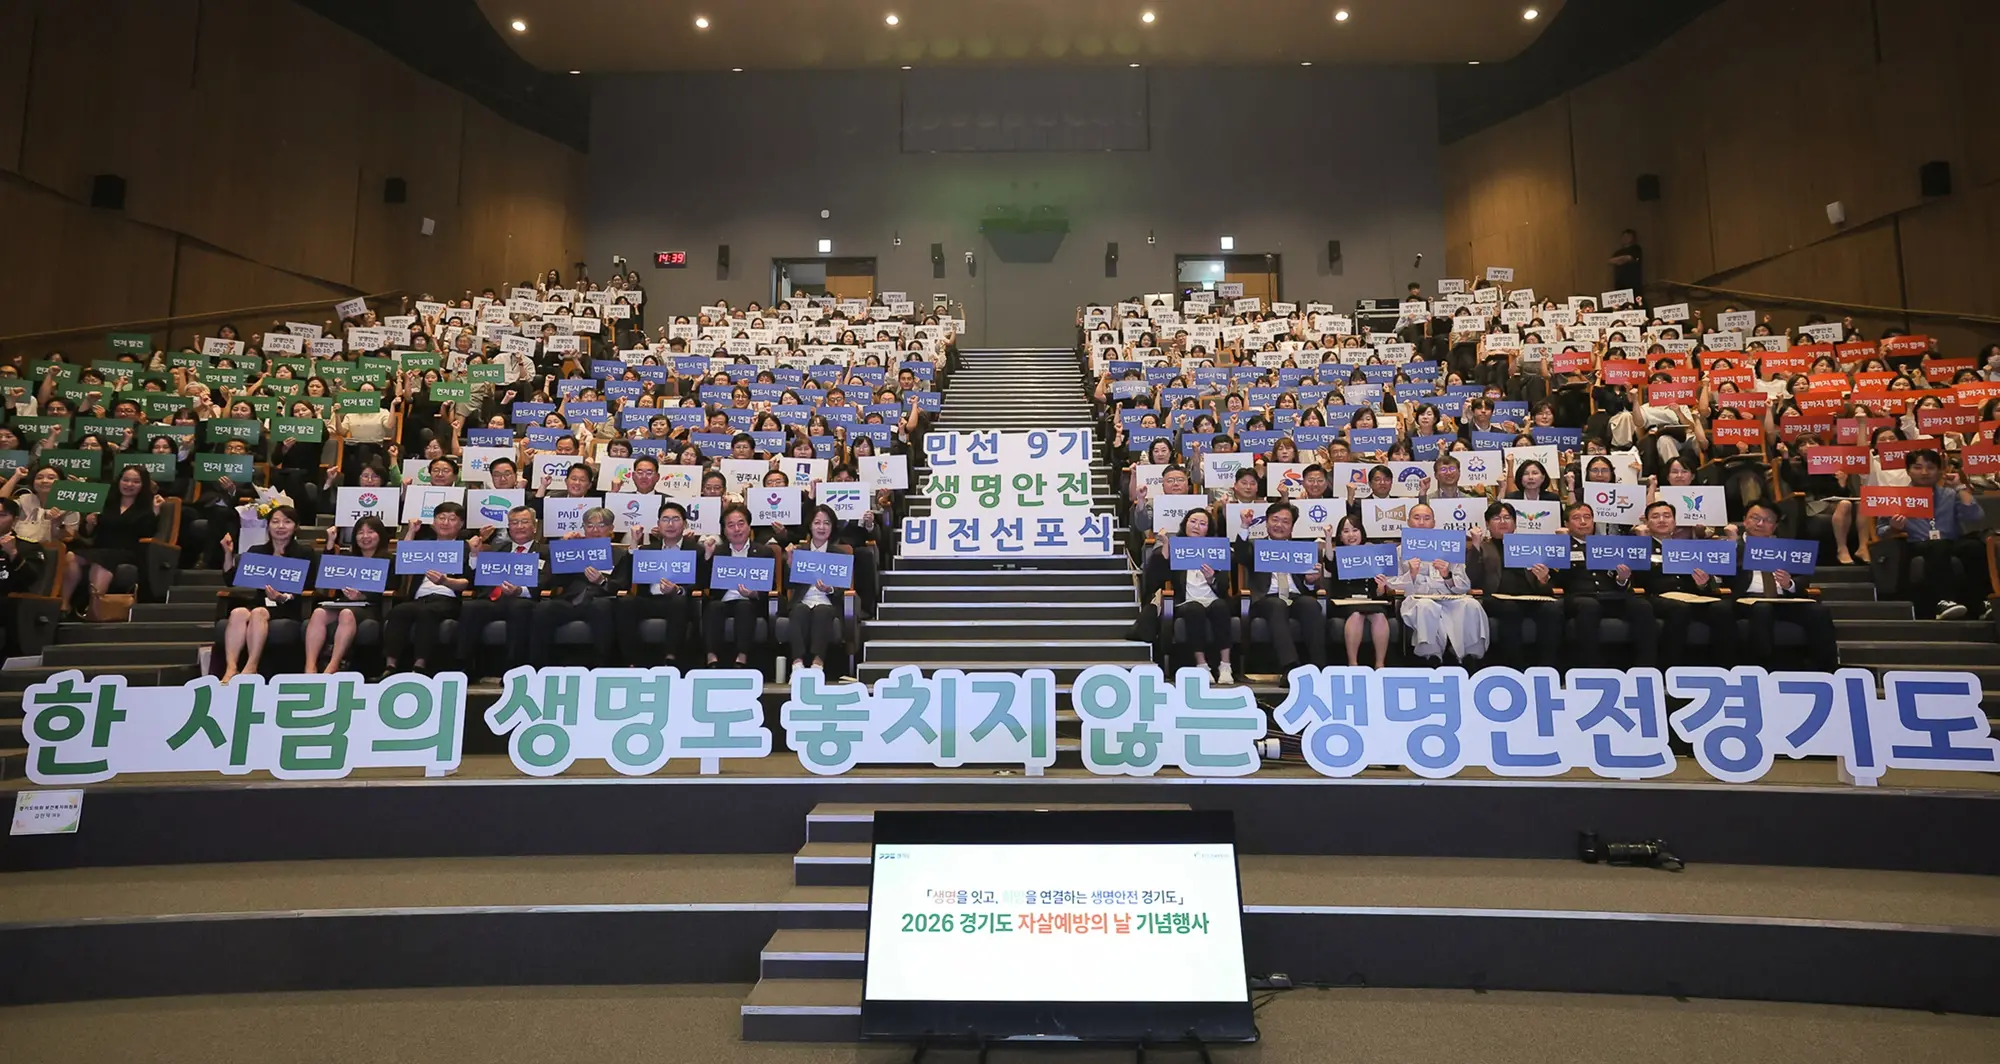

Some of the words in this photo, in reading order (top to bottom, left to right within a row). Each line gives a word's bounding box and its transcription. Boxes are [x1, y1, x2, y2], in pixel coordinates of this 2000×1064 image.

[658, 253, 684, 263] 14:39
[129, 340, 143, 348] 발견
[1766, 358, 1788, 367] 끝까지
[1790, 358, 1804, 366] 함께
[473, 369, 485, 377] 먼저
[486, 369, 498, 377] 발견
[1405, 368, 1423, 376] 반드시
[1609, 370, 1630, 378] 끝까지
[1632, 370, 1646, 378] 함께
[206, 374, 220, 383] 먼저
[222, 375, 236, 383] 발견
[367, 374, 379, 382] 발견
[451, 388, 464, 396] 발견
[628, 387, 640, 395] 연결
[1652, 391, 1675, 399] 끝까지
[1677, 390, 1694, 398] 함께
[343, 398, 358, 406] 먼저
[359, 398, 373, 407] 발견
[1801, 400, 1825, 408] 끝까지
[1827, 399, 1841, 407] 함께
[590, 408, 603, 416] 연결
[1923, 416, 1952, 427] 끝까지
[1955, 415, 1975, 425] 함께
[84, 425, 102, 434] 먼저
[105, 426, 124, 436] 발견
[215, 426, 231, 435] 먼저
[233, 425, 250, 435] 발견
[279, 425, 295, 434] 먼저
[297, 424, 314, 434] 발견
[1717, 427, 1741, 436] 끝까지
[1743, 428, 1759, 436] 함께
[1785, 423, 1811, 433] 끝까지
[1813, 423, 1830, 432] 함께
[495, 436, 509, 445] 연결
[1353, 436, 1376, 444] 반드시
[1378, 435, 1392, 444] 연결
[1537, 435, 1560, 444] 반드시
[1562, 436, 1577, 444] 연결
[926, 432, 998, 466] 민선
[1027, 430, 1089, 460] 9기
[49, 458, 68, 467] 먼저
[71, 459, 91, 469] 발견
[1812, 455, 1843, 465] 끝까지
[1846, 455, 1866, 465] 함께
[204, 463, 221, 472] 먼저
[224, 463, 242, 473] 발견
[736, 473, 760, 482] 광주시
[926, 472, 1089, 508] 생명안전
[57, 490, 76, 500] 먼저
[77, 491, 98, 502] 발견
[1596, 489, 1633, 513] 여주
[1866, 496, 1901, 507] 끝까지
[1905, 497, 1928, 508] 함께
[759, 510, 790, 519] 용인특례시
[1163, 509, 1189, 517] 고양특
[1684, 512, 1706, 520] 과천시
[905, 516, 1110, 552] 비전선포식
[1407, 539, 1437, 550] 반드시
[1441, 540, 1461, 553] 연결
[1509, 545, 1541, 557] 반드시
[1545, 545, 1565, 557] 연결
[402, 552, 434, 563] 반드시
[438, 551, 458, 563] 연결
[556, 550, 584, 562] 반드시
[588, 549, 607, 560] 연결
[1175, 547, 1204, 559] 반드시
[1208, 547, 1226, 559] 연결
[1260, 550, 1290, 563] 반드시
[1293, 552, 1312, 564] 연결
[1592, 546, 1624, 559] 반드시
[1627, 548, 1647, 559] 연결
[1668, 550, 1703, 562] 반드시
[1707, 550, 1730, 563] 연결
[1751, 548, 1786, 561] 반드시
[1791, 551, 1812, 564] 연결
[1342, 556, 1371, 568] 반드시
[1375, 554, 1393, 566] 연결
[481, 563, 511, 575] 반드시
[514, 564, 533, 575] 연결
[638, 561, 667, 573] 반드시
[671, 561, 691, 573] 연결
[797, 561, 826, 573] 반드시
[829, 564, 847, 576] 연결
[243, 564, 277, 579] 반드시
[280, 568, 301, 582] 연결
[324, 566, 357, 578] 반드시
[360, 569, 382, 581] 연결
[717, 567, 746, 579] 반드시
[750, 568, 769, 580] 연결
[33, 678, 126, 775] 한
[166, 680, 458, 771] 사람의
[494, 674, 762, 767] 생명도
[789, 673, 1046, 767] 놓치지
[1081, 674, 1257, 767] 않는
[1040, 890, 1087, 904] 연결하는
[1091, 890, 1138, 904] 생명안전
[901, 913, 954, 932] 2026
[960, 913, 1013, 934] 경기도
[1018, 912, 1108, 934] 자살예방의
[1114, 913, 1131, 934] 날
[1137, 912, 1209, 934] 기념행사
